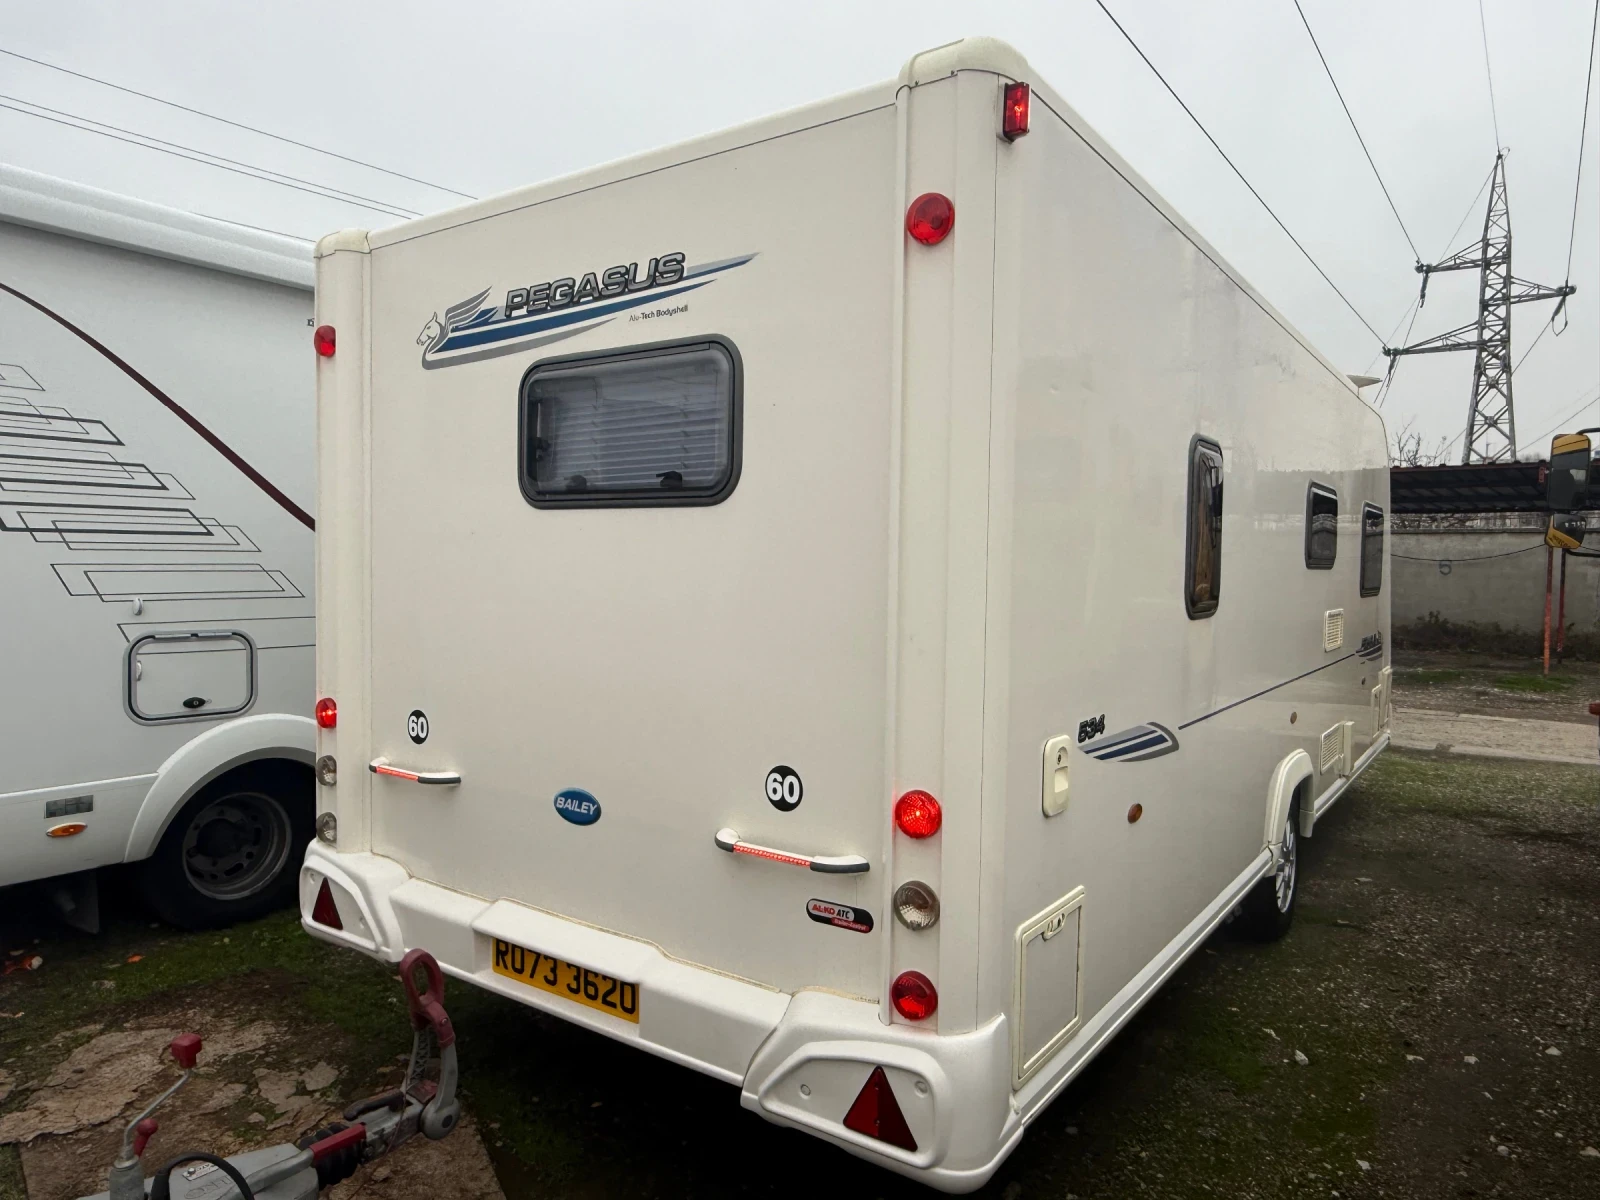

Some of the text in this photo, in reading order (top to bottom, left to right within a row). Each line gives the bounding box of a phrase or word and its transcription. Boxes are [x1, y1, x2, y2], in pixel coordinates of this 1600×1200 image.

[504, 252, 686, 318] PEGASUS
[629, 304, 688, 322] Alu-Tech Bodyshell
[409, 715, 427, 738] 60
[767, 772, 800, 804] 60
[556, 797, 597, 815] BAILEY
[836, 909, 851, 919] ATC
[495, 939, 636, 1015] RO73 3620
